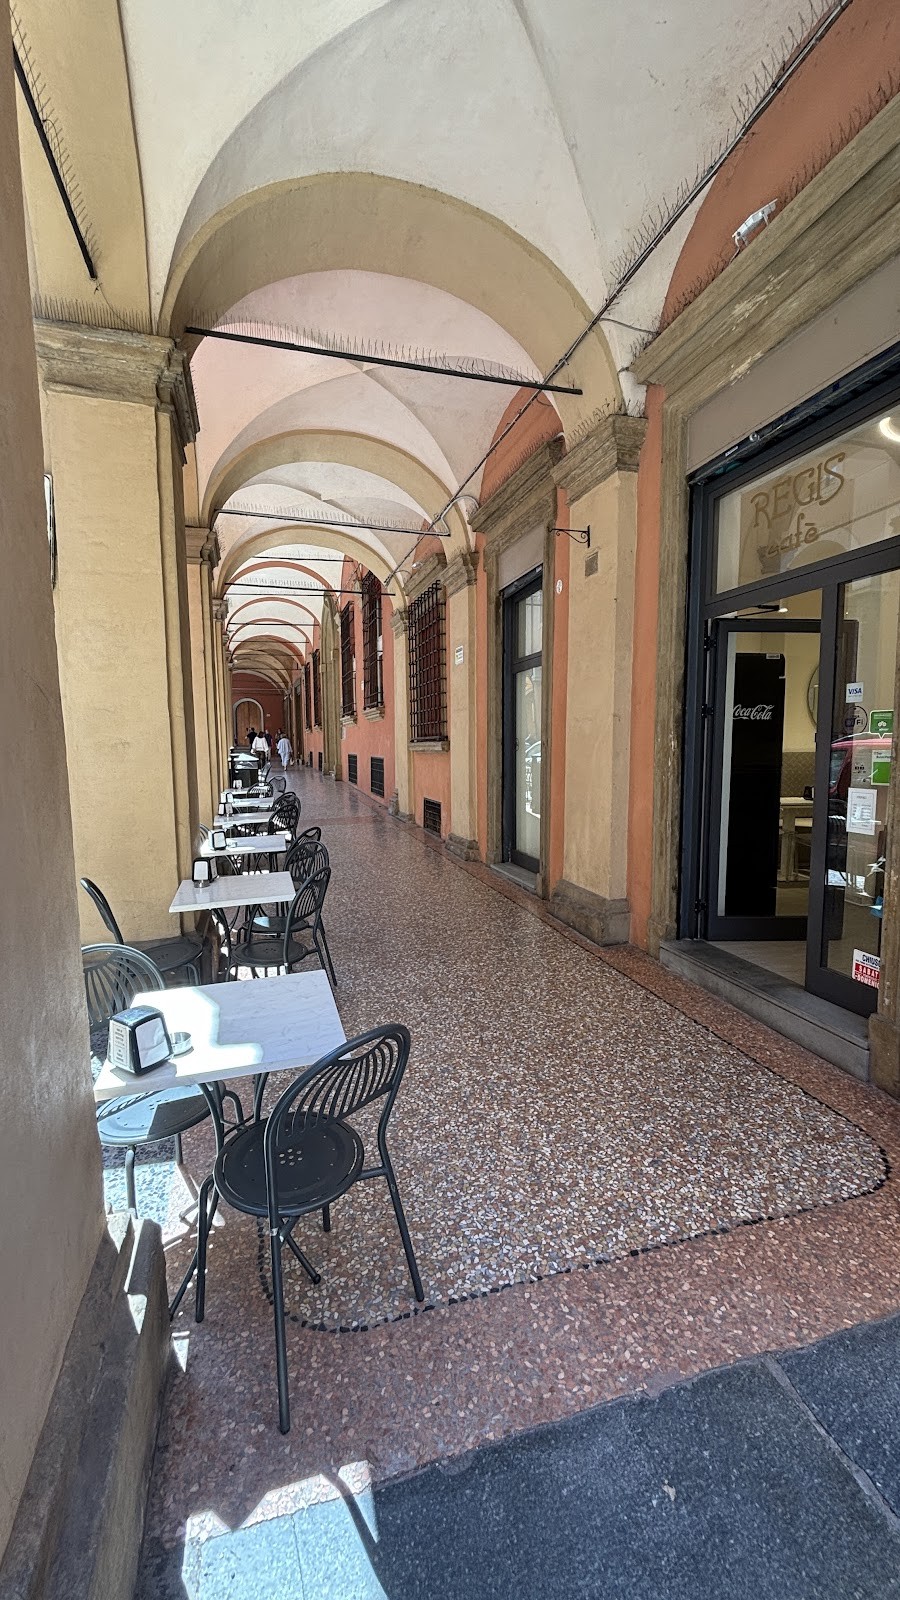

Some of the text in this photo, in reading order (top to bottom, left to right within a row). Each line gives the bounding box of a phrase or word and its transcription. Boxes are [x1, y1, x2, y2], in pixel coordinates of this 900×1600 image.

[751, 452, 845, 528] REGIS
[858, 965, 879, 979] SABAT
[857, 974, 880, 989] DOMENIC
